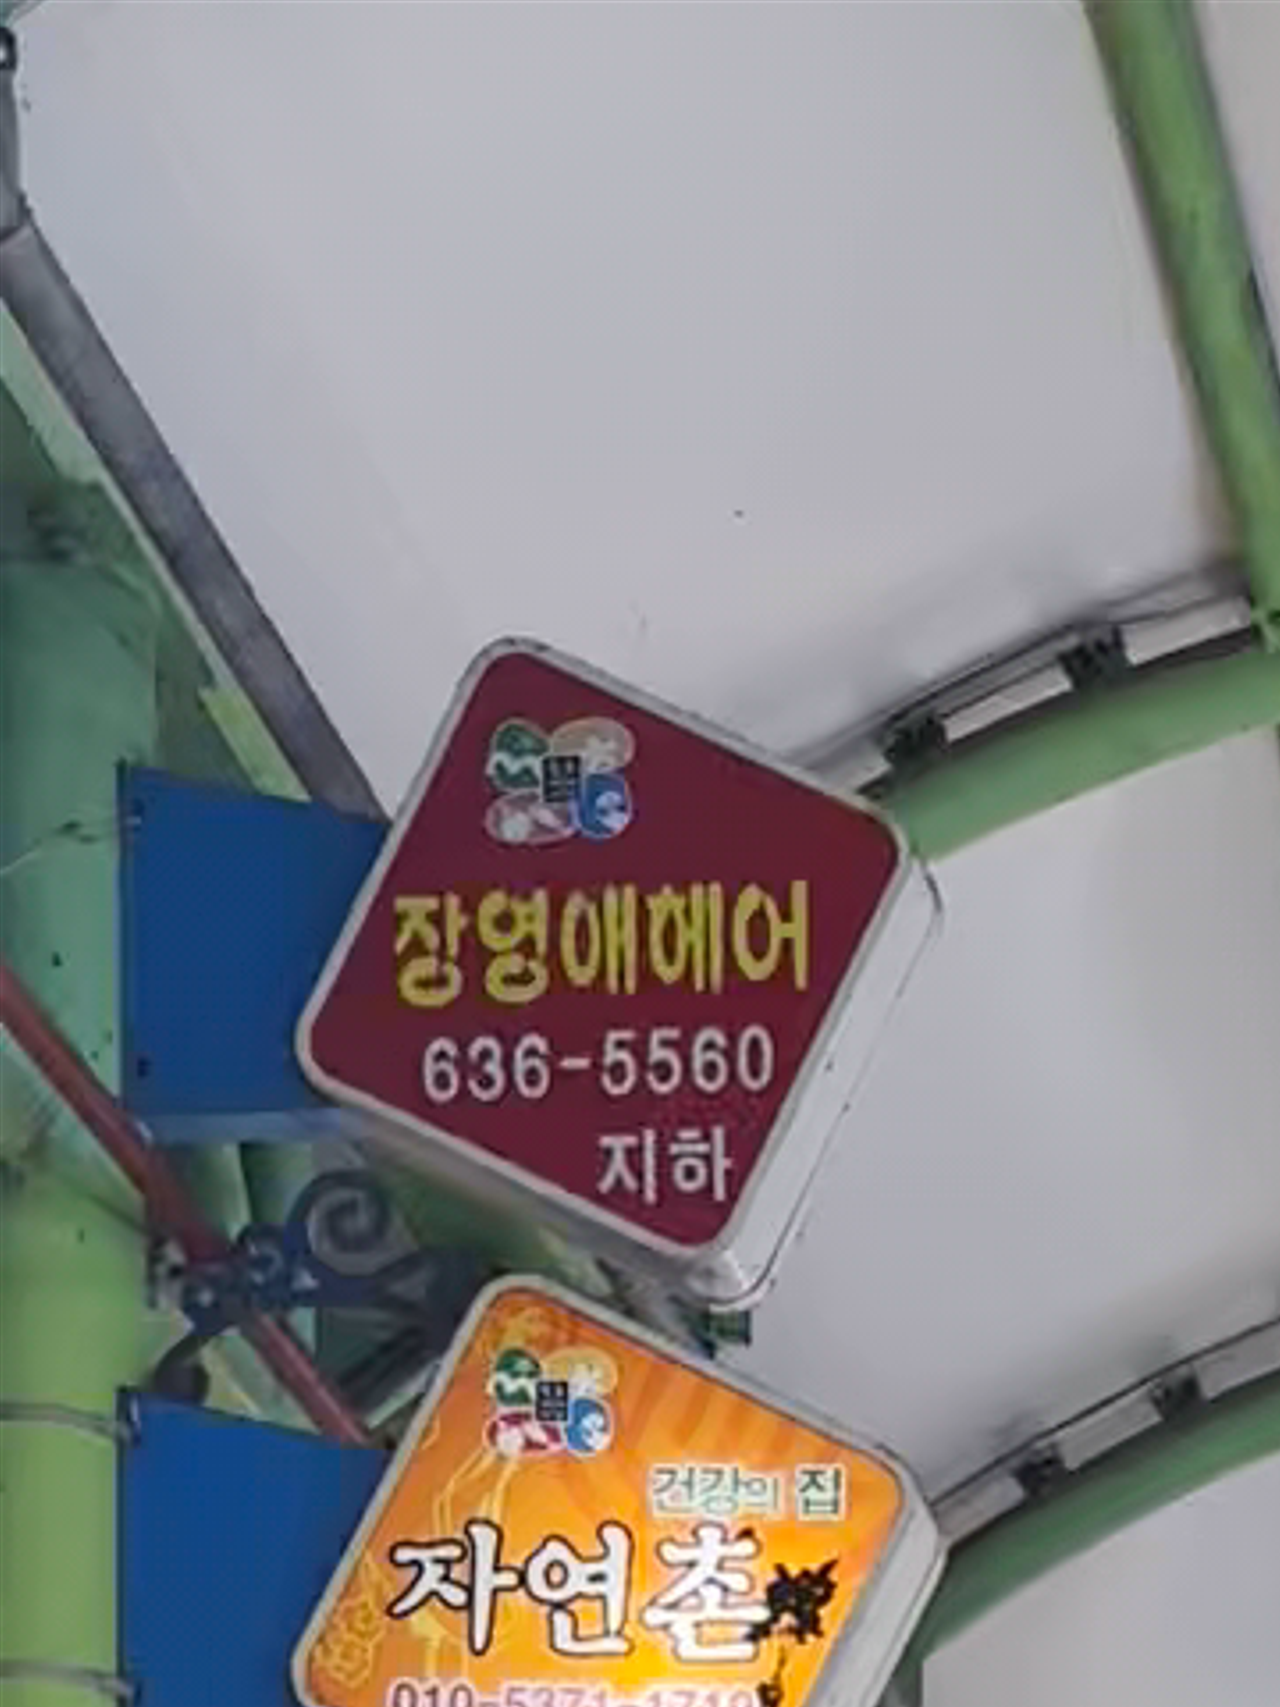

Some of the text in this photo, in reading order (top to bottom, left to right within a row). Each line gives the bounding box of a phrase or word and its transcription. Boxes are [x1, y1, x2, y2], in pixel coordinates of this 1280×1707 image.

[393, 881, 810, 1006] 장영애헤어
[422, 1025, 774, 1101] 636-5560
[598, 1126, 734, 1203] 지하
[650, 1464, 845, 1516] 건강의 집
[387, 1521, 772, 1660] 자연촌
